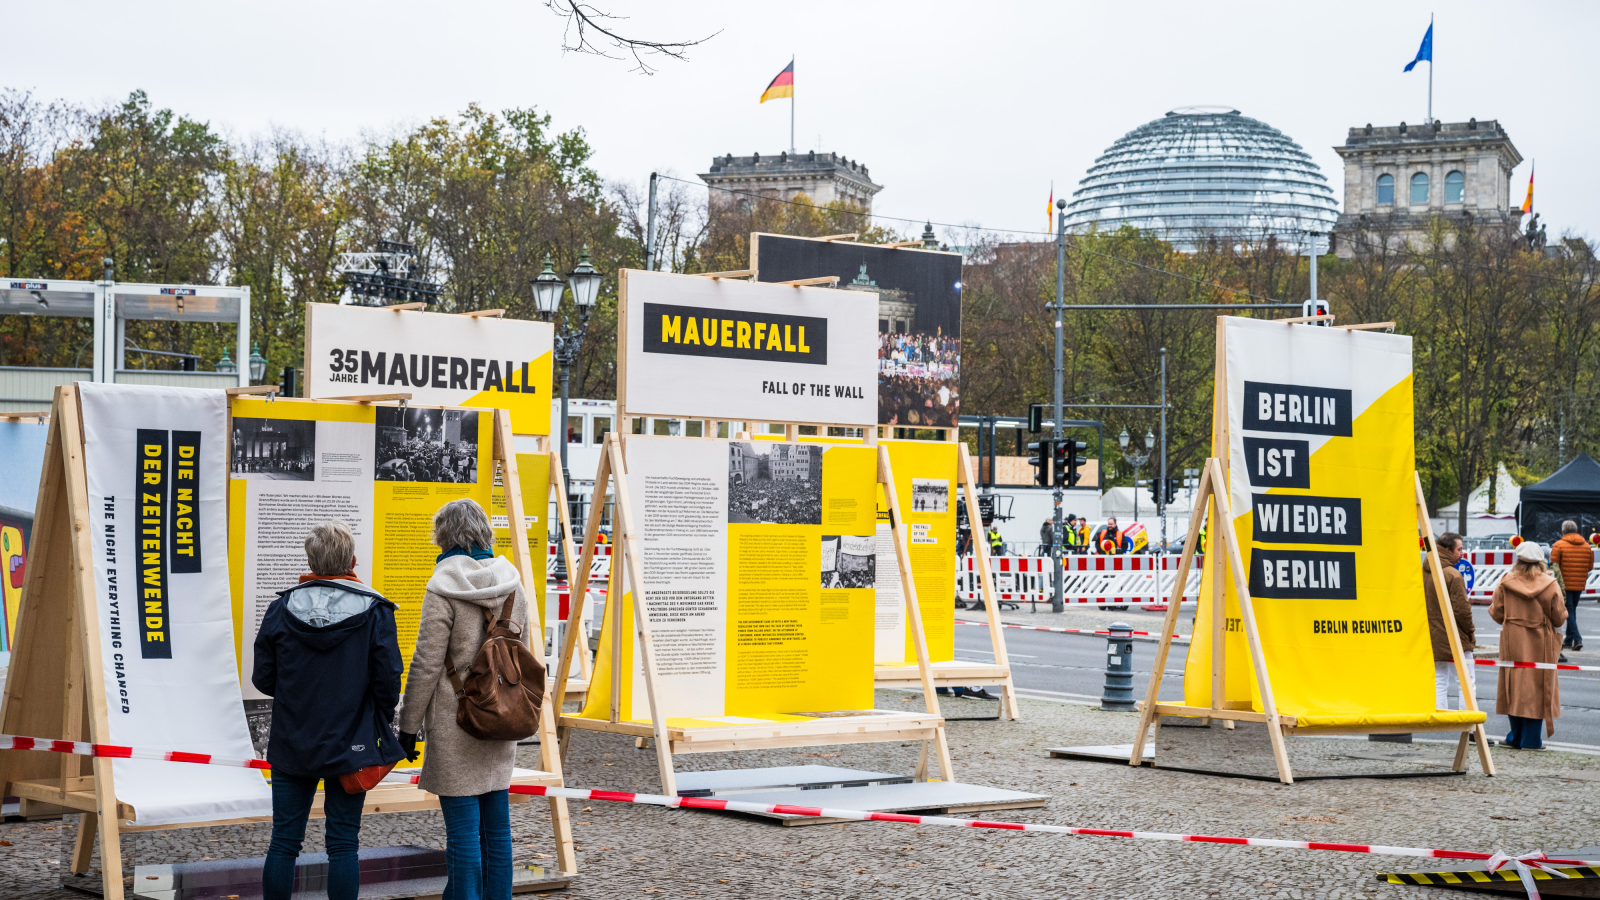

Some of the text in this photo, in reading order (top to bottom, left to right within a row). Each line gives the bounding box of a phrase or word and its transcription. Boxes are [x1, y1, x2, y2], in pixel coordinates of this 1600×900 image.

[661, 314, 810, 354] MAUERFALL
[330, 348, 536, 394] 35 MAUERFALL
[330, 373, 358, 384] JAHRE
[762, 380, 864, 399] FALL OF THE WALL
[1258, 392, 1336, 426] BERLIN
[1258, 448, 1296, 477] IST
[176, 445, 195, 558] DIE NACHT
[1258, 504, 1347, 535] WIEDER
[142, 444, 164, 643] DER ZEITENWENDE
[1262, 560, 1341, 589] BERLIN
[104, 496, 130, 714] THE NIGHT EVERYTHING CHANGED
[1314, 620, 1402, 634] BERLIN REUNITED
